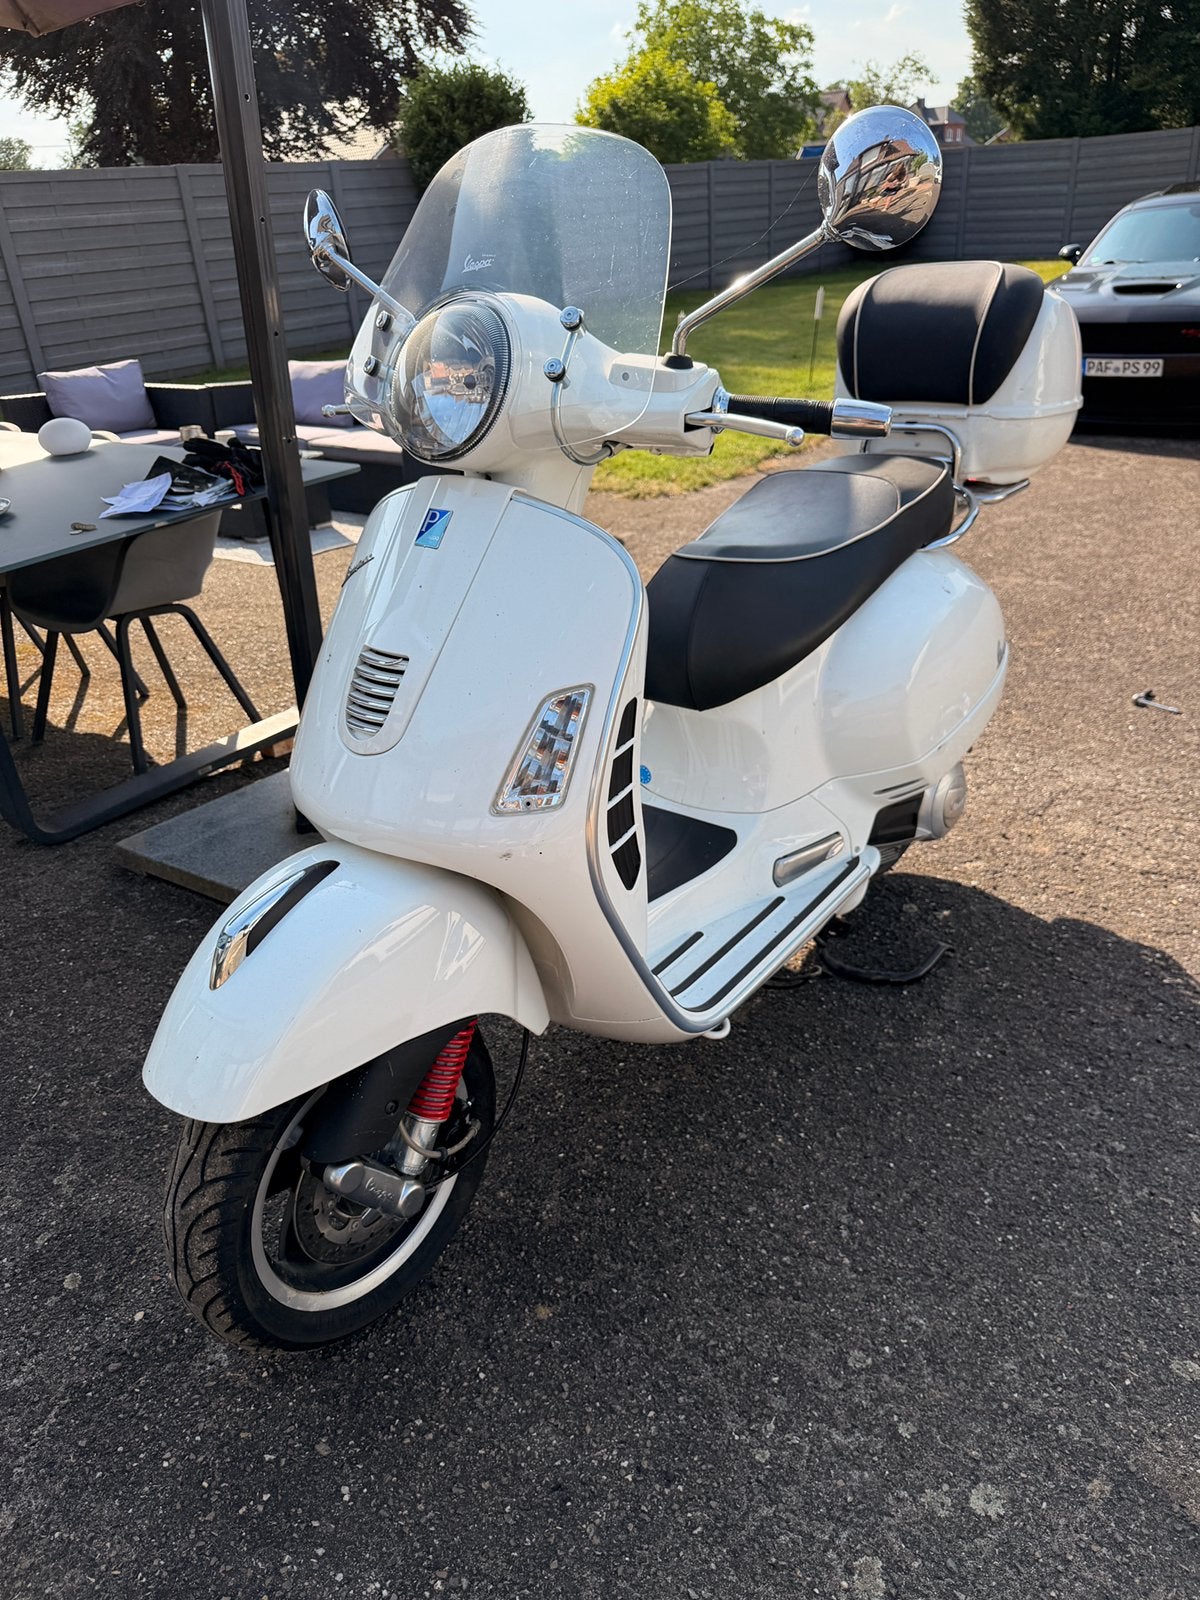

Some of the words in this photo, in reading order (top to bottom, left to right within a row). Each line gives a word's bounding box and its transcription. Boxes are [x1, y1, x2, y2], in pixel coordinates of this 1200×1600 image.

[461, 254, 494, 273] Vespa
[1087, 361, 1113, 373] PAF
[1122, 362, 1140, 374] PS
[1143, 362, 1161, 374] 99
[421, 510, 440, 532] P
